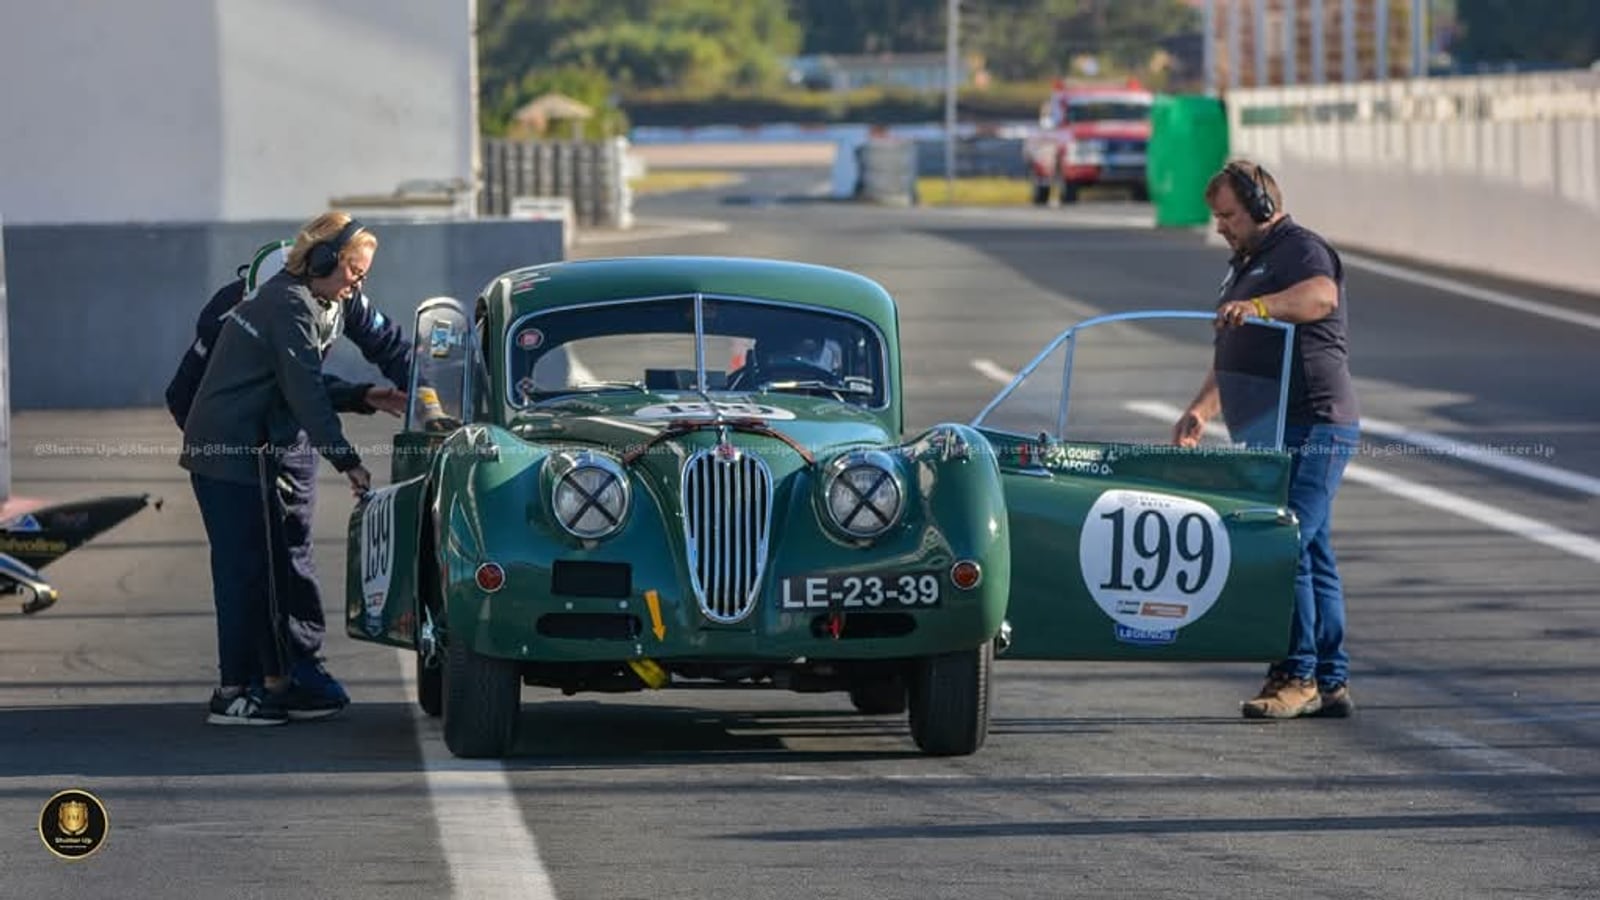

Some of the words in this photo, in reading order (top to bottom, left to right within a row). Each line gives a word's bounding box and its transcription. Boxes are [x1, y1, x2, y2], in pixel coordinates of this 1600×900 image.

[365, 494, 391, 584] 199
[1100, 507, 1214, 595] 199
[782, 574, 939, 608] LE-23-39
